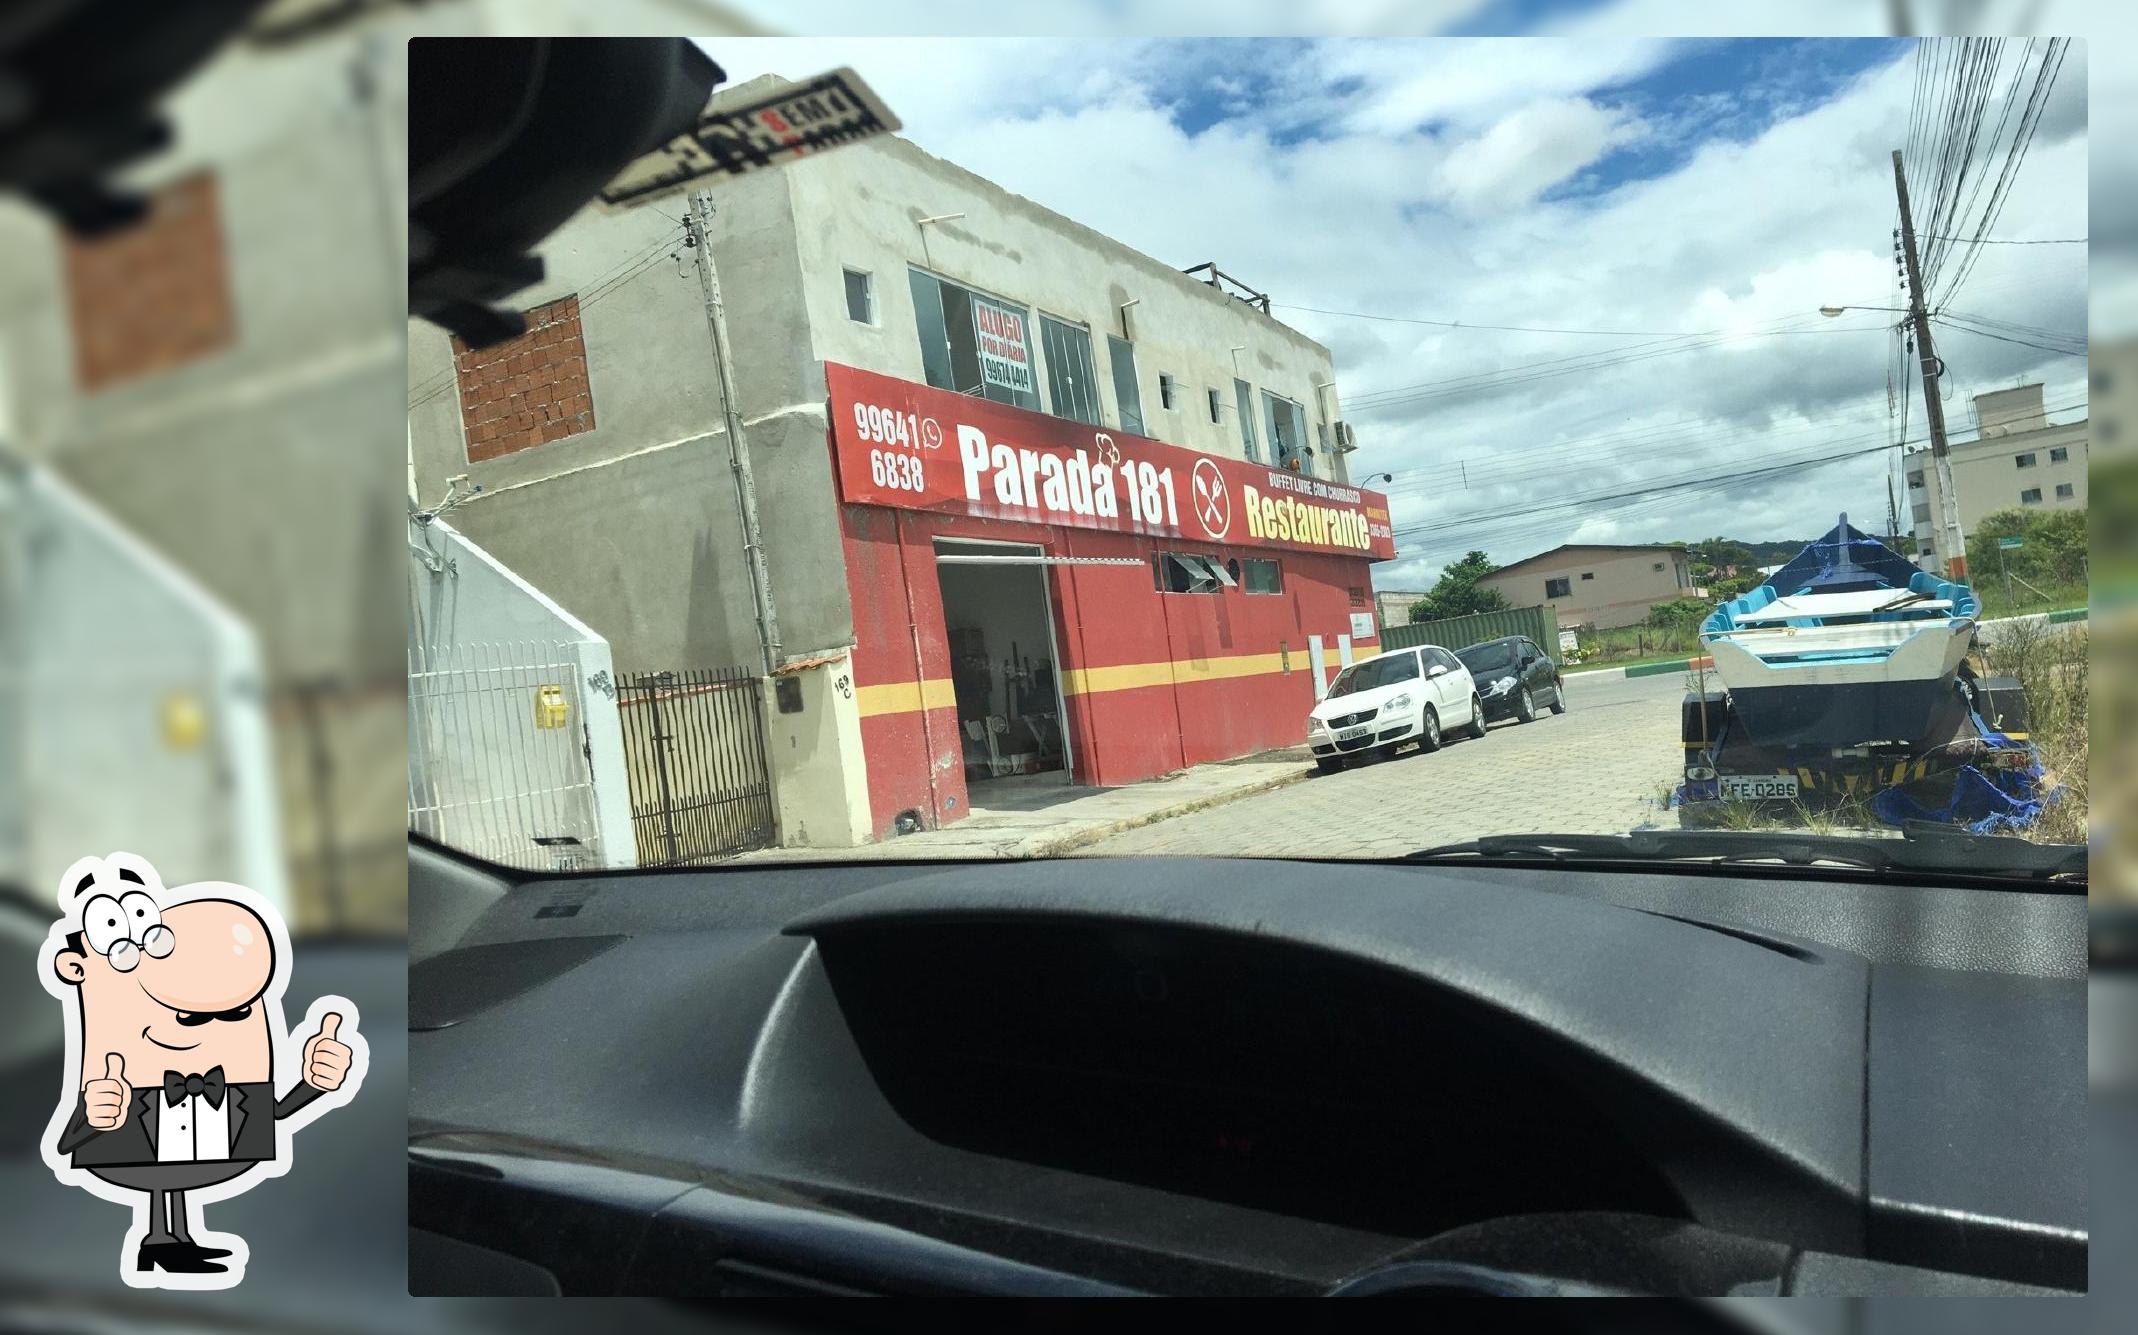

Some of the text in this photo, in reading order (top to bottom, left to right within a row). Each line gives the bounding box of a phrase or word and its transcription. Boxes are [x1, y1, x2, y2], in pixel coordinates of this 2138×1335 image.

[979, 304, 1021, 343] ALUGO
[982, 335, 999, 356] POR
[853, 402, 920, 450] 99641
[870, 448, 924, 493] 6838
[956, 423, 1179, 526] Parada 181
[1268, 472, 1294, 491] BUFFET
[1293, 477, 1313, 496] LIVRE
[1243, 484, 1371, 550] Restaurante
[835, 675, 849, 693] 169
[844, 688, 851, 699] C
